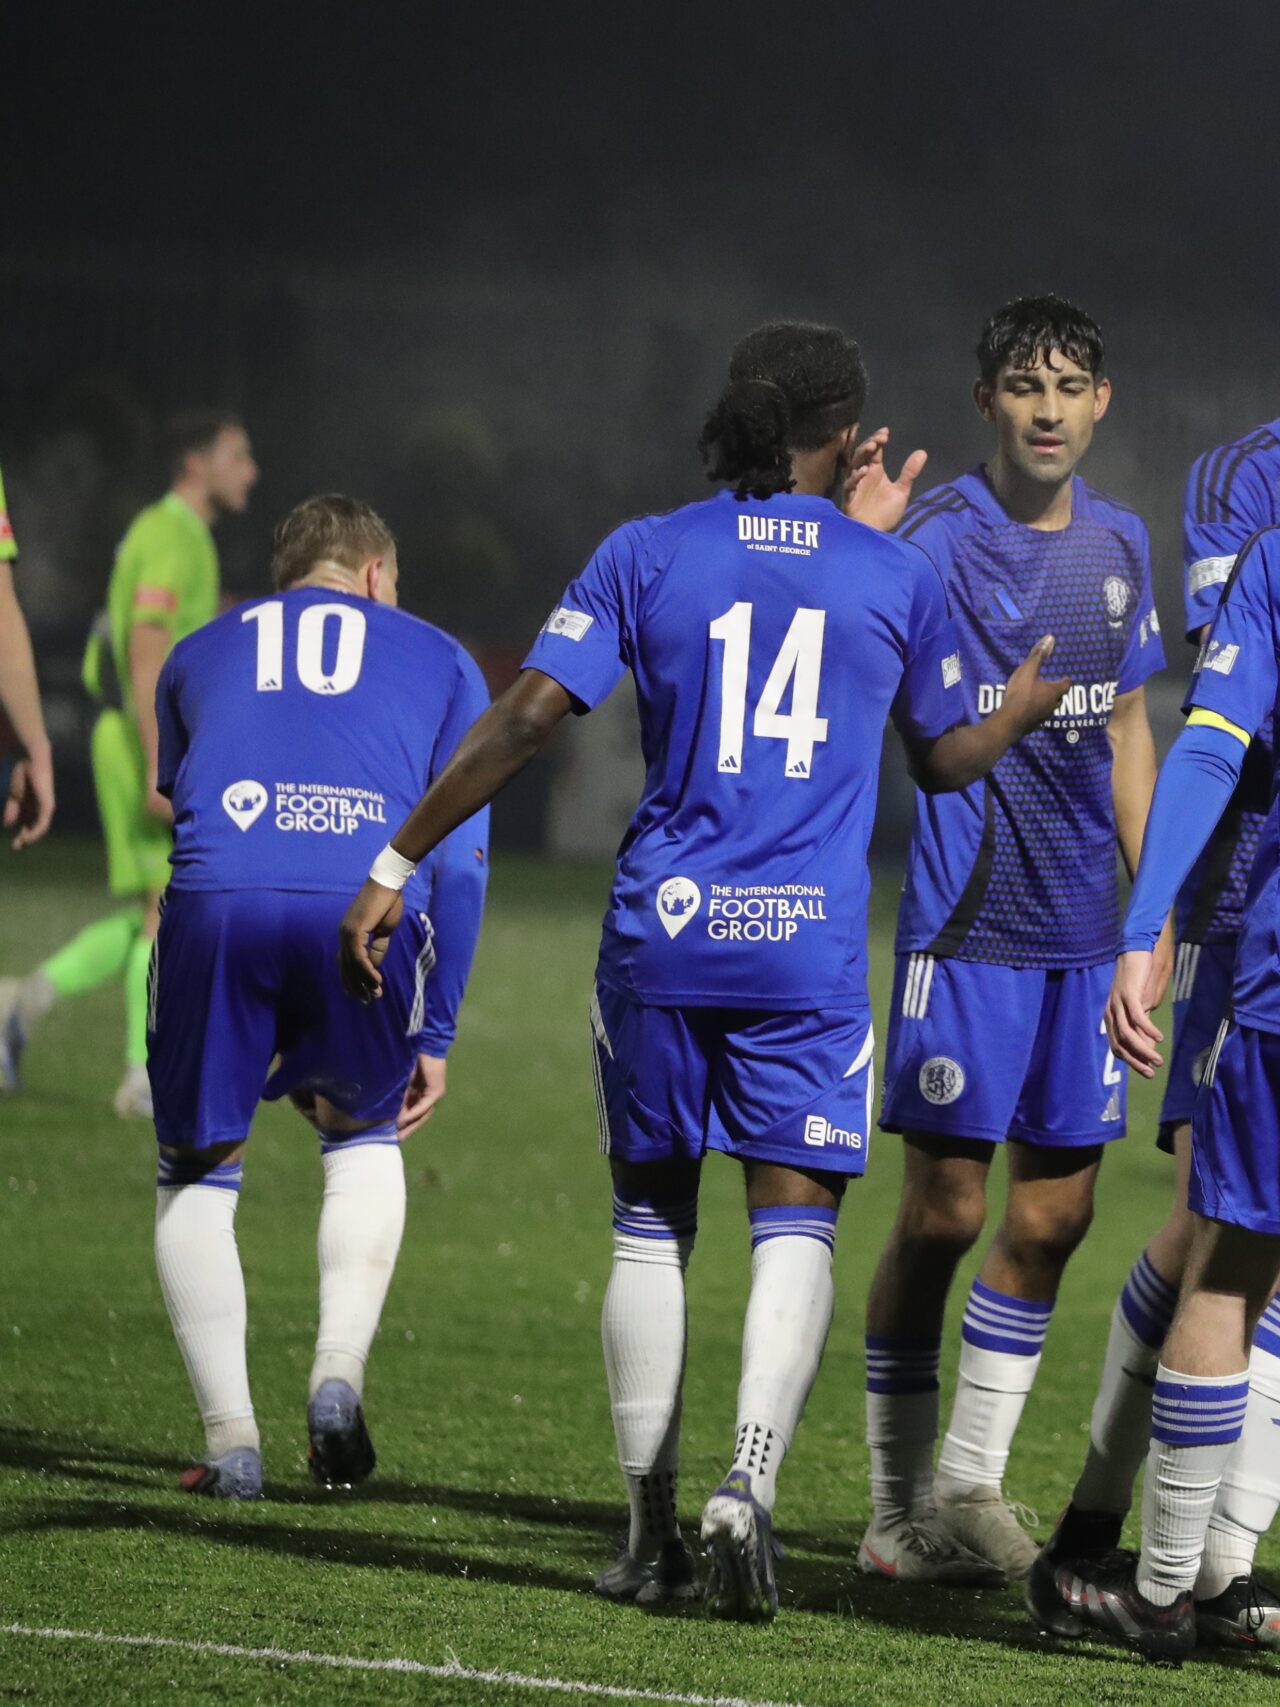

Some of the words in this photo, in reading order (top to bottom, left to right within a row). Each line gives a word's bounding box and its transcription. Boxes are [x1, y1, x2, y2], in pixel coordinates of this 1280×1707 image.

[738, 514, 819, 549] DUFFER
[754, 544, 778, 553] SAINT
[779, 546, 811, 556] GEORGE
[241, 601, 366, 695] 10
[709, 601, 829, 779] 14
[275, 782, 296, 793] THE
[298, 784, 386, 804] INTERNATIONAL
[275, 794, 387, 824] FOOTBALL
[275, 812, 359, 836] GROUP
[710, 884, 732, 897] THE
[735, 885, 826, 897] INTERNATIONAL
[708, 899, 827, 920] FOOTBALL
[707, 919, 798, 941] GROUP
[804, 1114, 862, 1149] Elms
